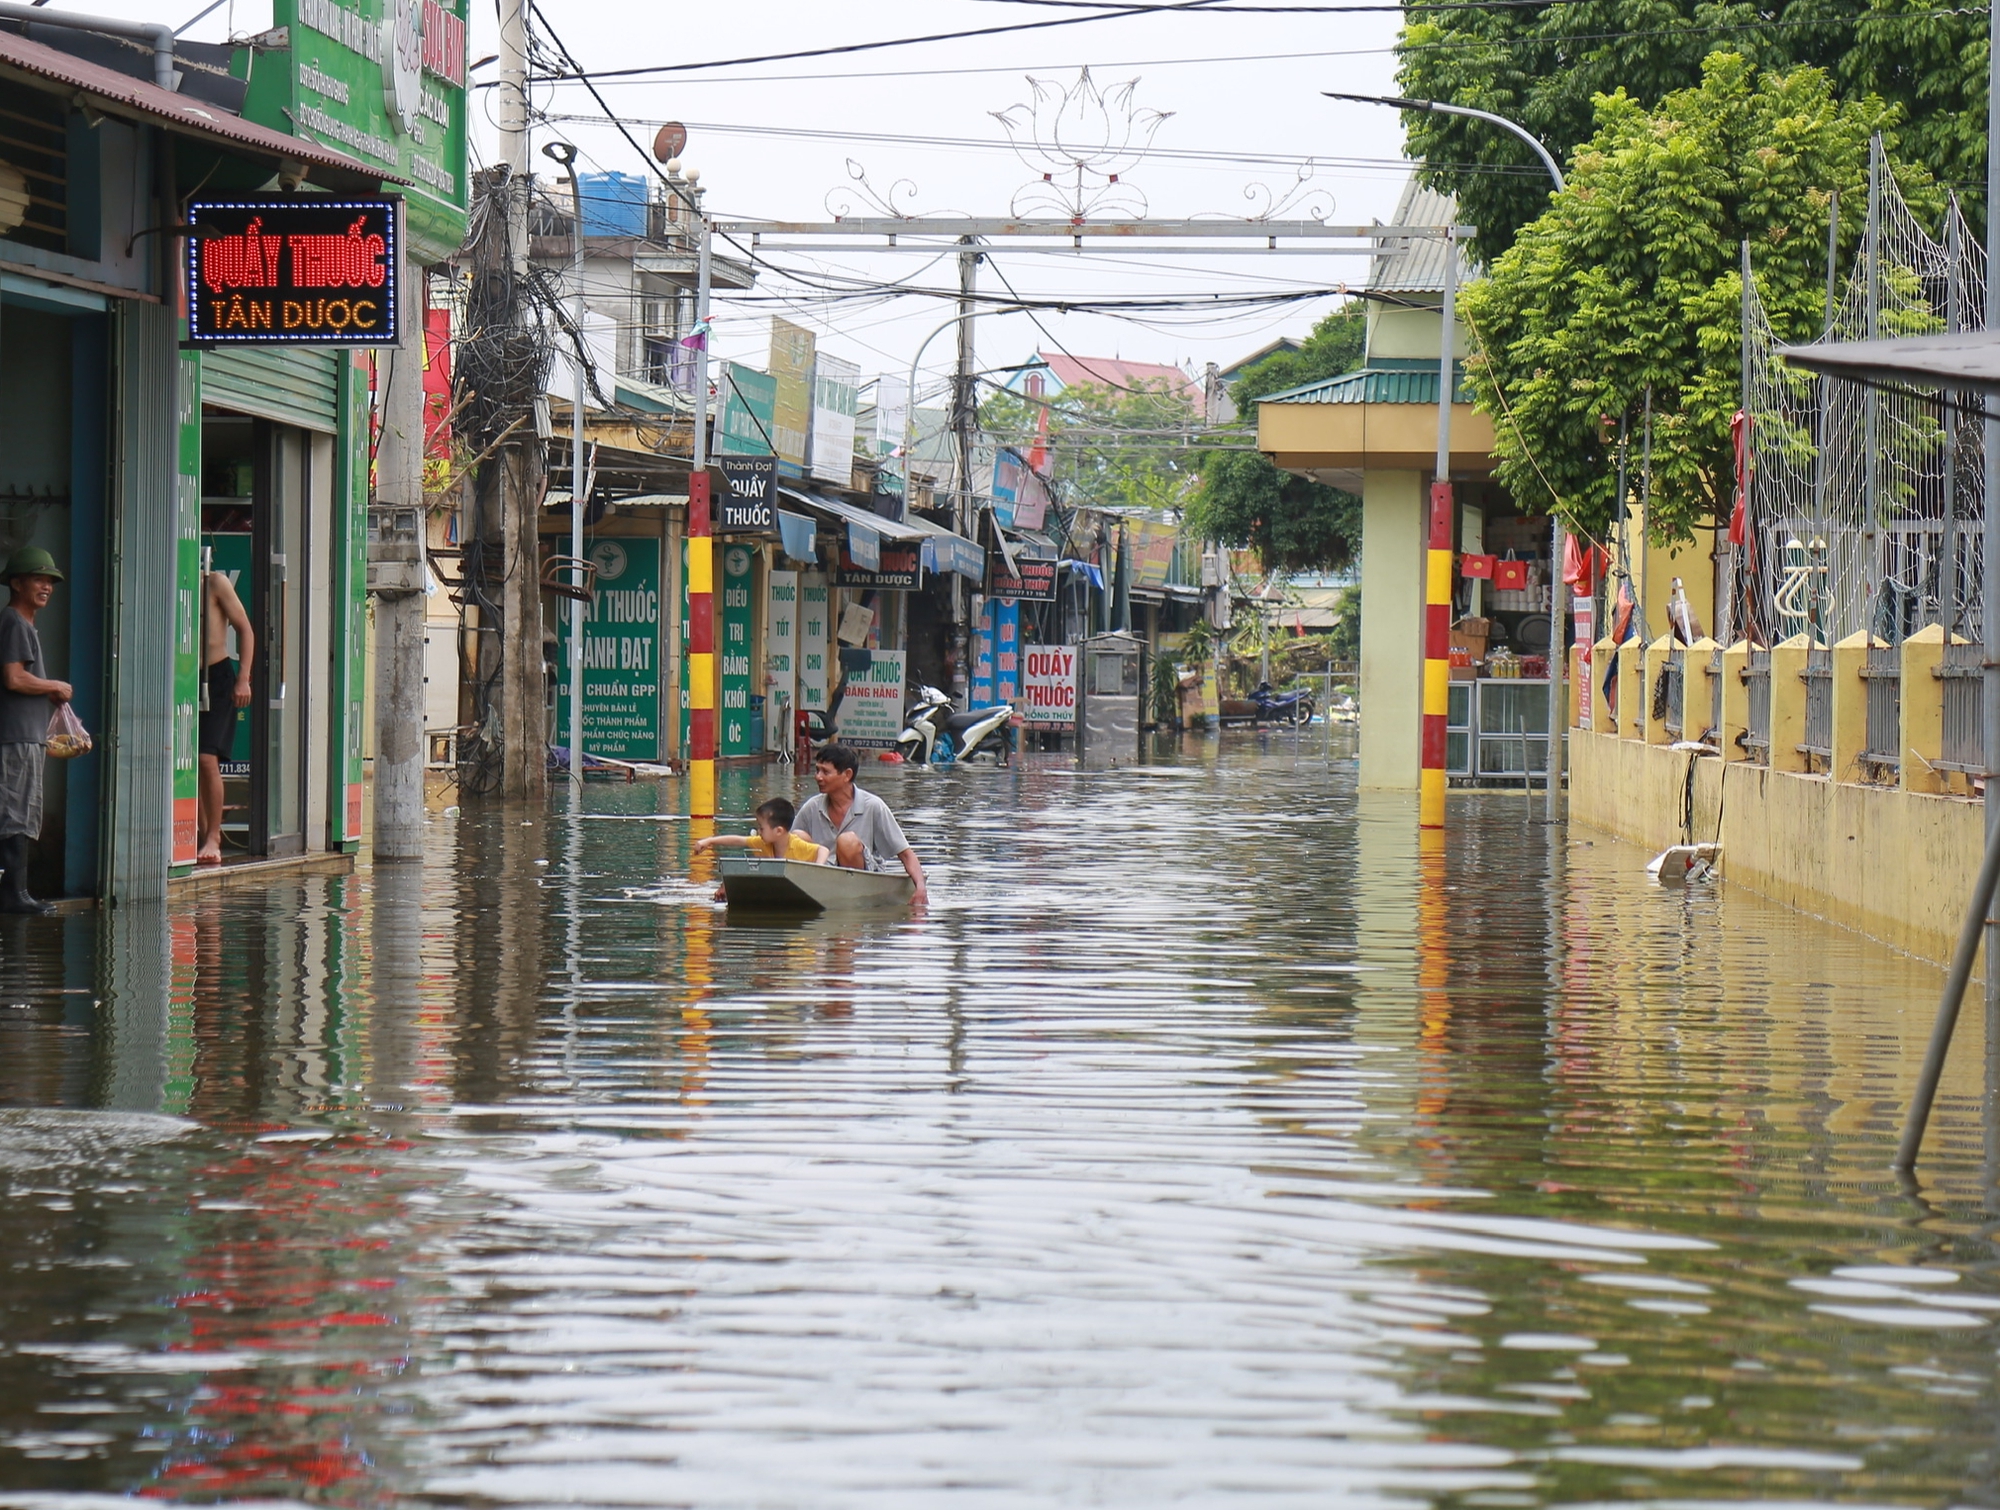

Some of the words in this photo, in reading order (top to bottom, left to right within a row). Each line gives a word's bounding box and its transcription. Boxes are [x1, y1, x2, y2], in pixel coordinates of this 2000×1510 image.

[203, 215, 282, 293] QUẦY
[288, 215, 386, 287] THUỐC
[210, 294, 271, 329] TÂN
[283, 298, 377, 334] DƯỢC
[725, 460, 753, 471] Thành
[755, 462, 773, 472] Đạt
[725, 502, 771, 526] THUỐC
[844, 571, 871, 583] TÂN
[875, 574, 912, 587] DƯỢC
[1021, 562, 1054, 578] THUỐC
[606, 579, 657, 623] THUỐC
[771, 581, 796, 601] THUỐC
[803, 584, 827, 602] THUỐC
[729, 623, 743, 645] TRỊ
[776, 615, 790, 636] TỐT
[807, 616, 821, 636] TỐT
[564, 629, 616, 670] TÀNH
[621, 637, 651, 677] ĐẠT
[723, 649, 748, 675] BẰNG
[806, 654, 821, 670] CHO
[1028, 647, 1073, 678] QUẦY
[871, 654, 901, 684] THUỐC
[586, 679, 628, 696] CHUẨN
[631, 684, 656, 697] GPP
[724, 684, 746, 708] KHỐI
[807, 688, 821, 706] MỌI
[1026, 679, 1074, 707] THUỐC
[597, 714, 622, 726] THÀNH
[624, 713, 647, 727] PHẨM
[729, 719, 741, 742] ÓC
[631, 730, 655, 740] NĂNG
